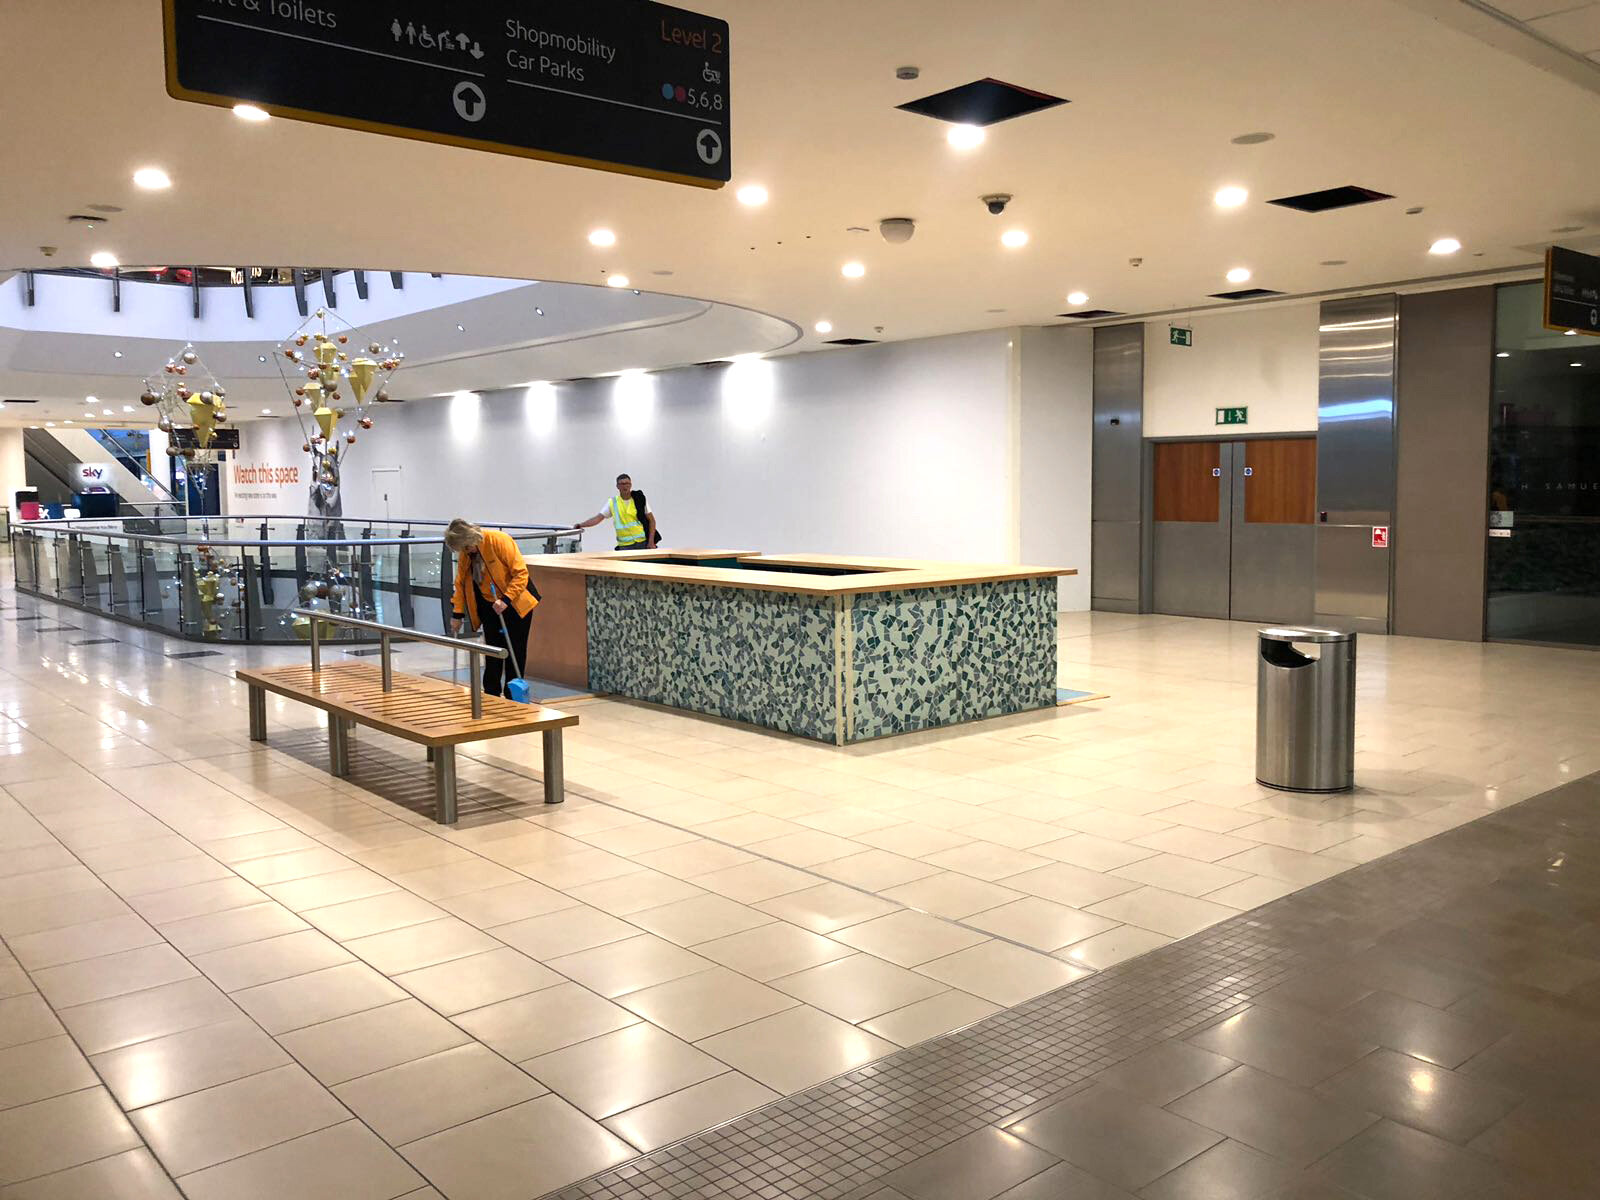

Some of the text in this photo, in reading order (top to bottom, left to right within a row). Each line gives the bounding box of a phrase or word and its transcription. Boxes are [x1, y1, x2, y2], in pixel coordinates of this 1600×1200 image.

[506, 19, 616, 64] Shopmobility
[661, 20, 722, 54] Level 2
[506, 50, 585, 82] Car Parks
[687, 88, 723, 111] 5,6,8
[82, 466, 103, 479] sky
[234, 462, 299, 488] Watch this space
